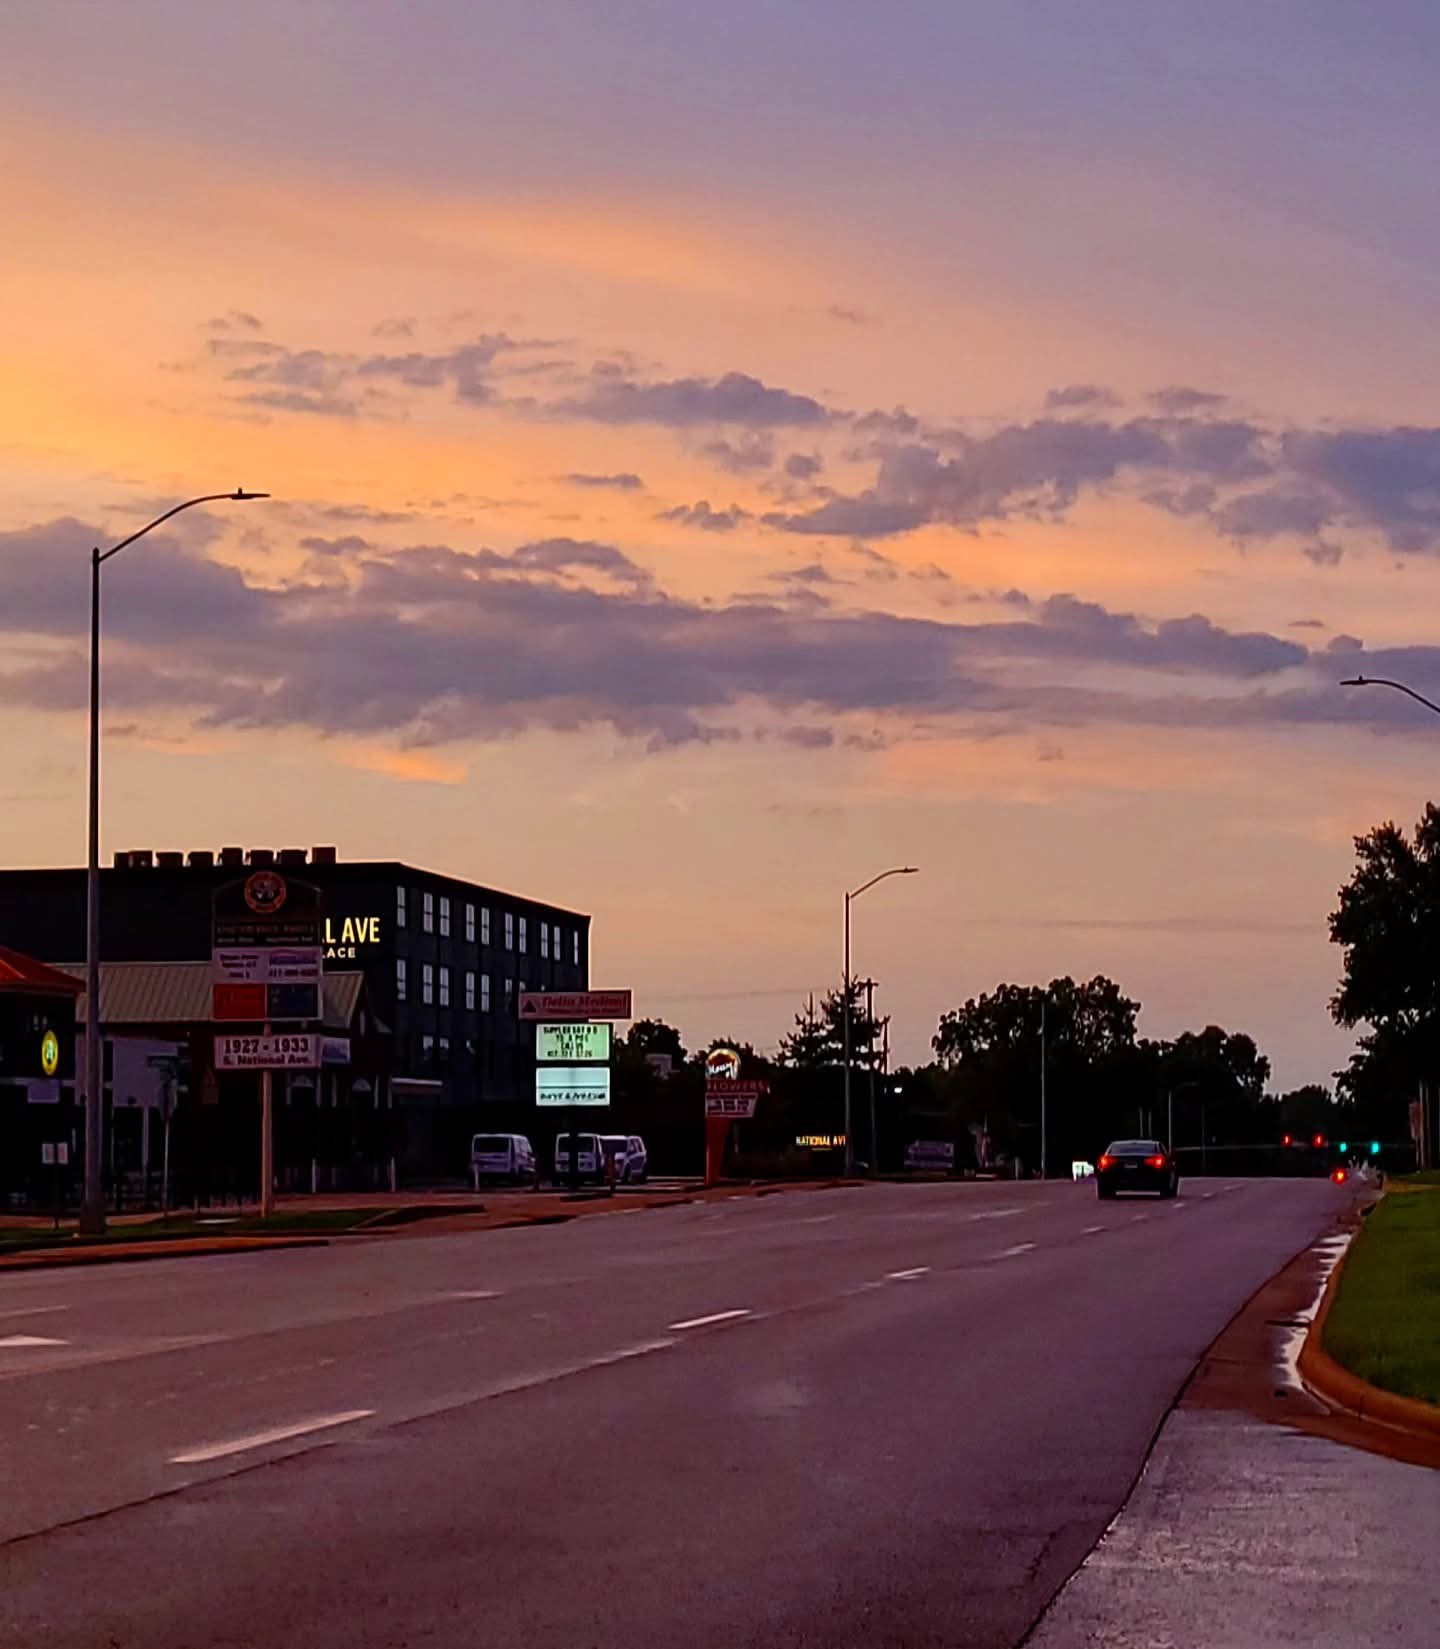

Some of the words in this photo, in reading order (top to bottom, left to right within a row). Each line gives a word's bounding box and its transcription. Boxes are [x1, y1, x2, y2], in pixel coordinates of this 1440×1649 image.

[342, 916, 381, 943] AVE
[322, 947, 357, 959] ACE
[225, 1039, 259, 1053] 1927
[274, 1038, 309, 1052] 1933
[238, 1055, 285, 1065] National
[796, 1135, 830, 1145] NATIONAL
